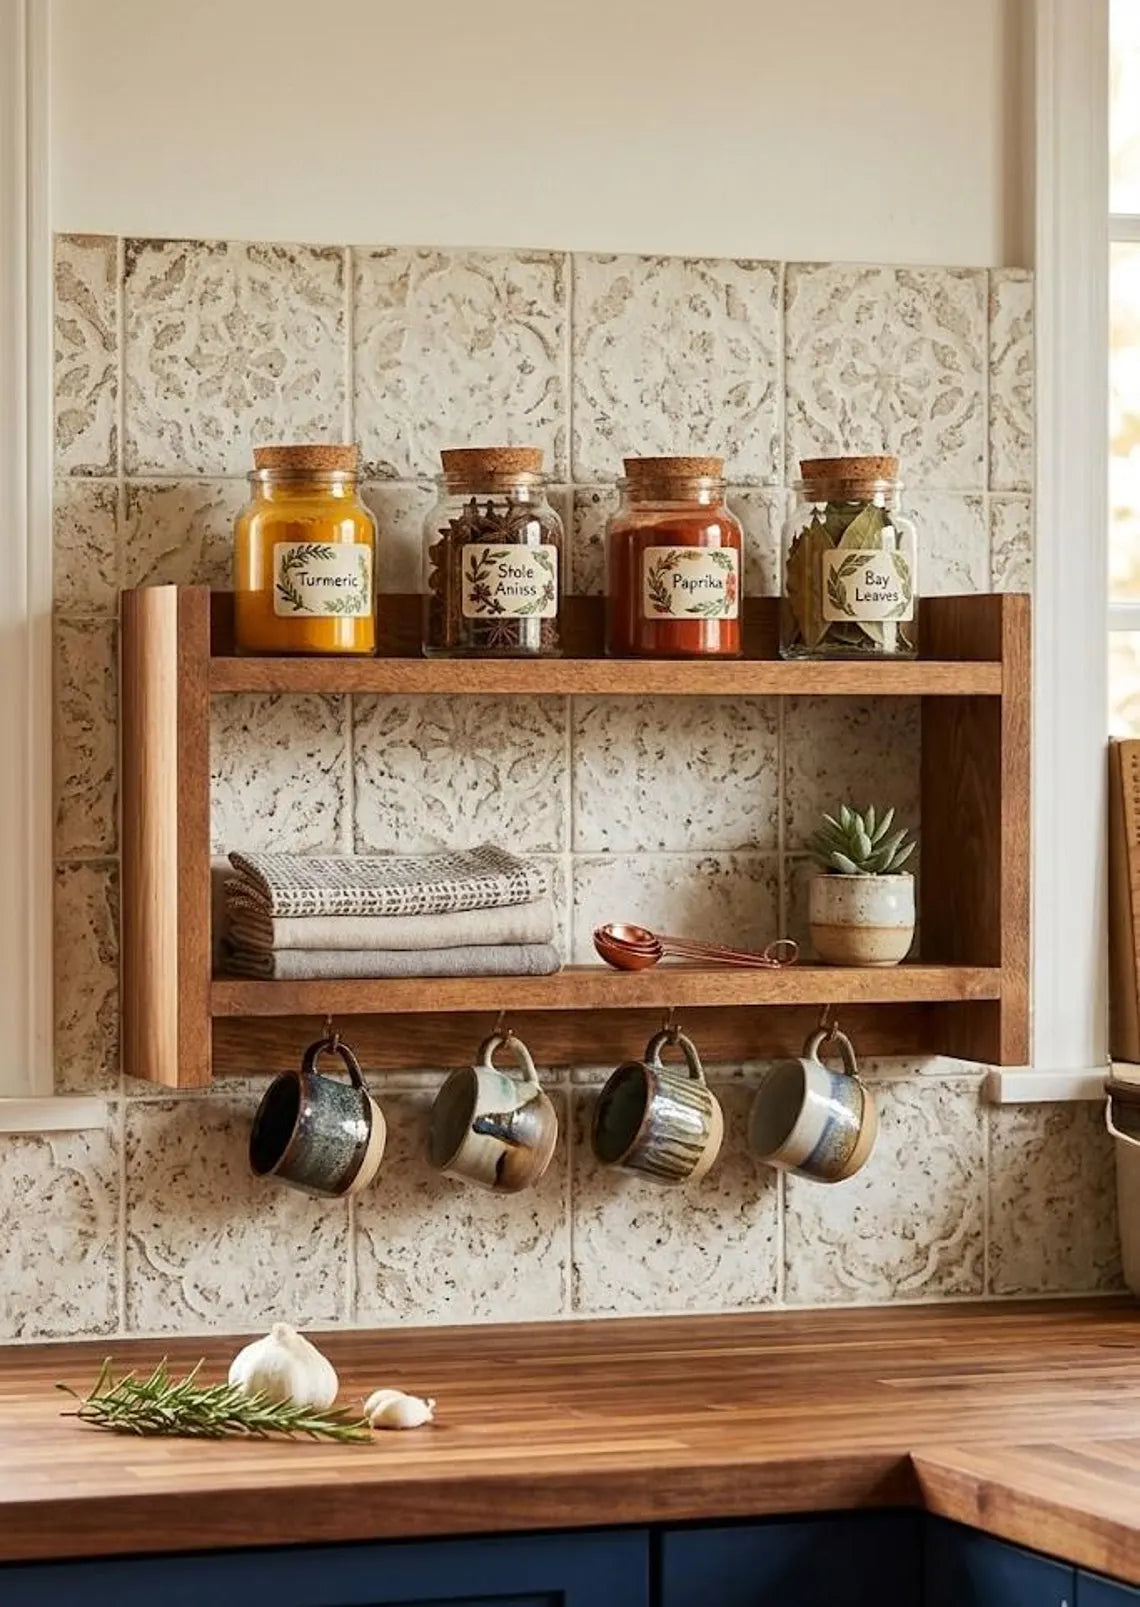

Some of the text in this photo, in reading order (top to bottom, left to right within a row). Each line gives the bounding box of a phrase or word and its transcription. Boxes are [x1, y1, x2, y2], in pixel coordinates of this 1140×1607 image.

[295, 571, 358, 587] Turmeric
[672, 573, 723, 594] Paprika
[865, 570, 890, 589] Bay
[855, 587, 899, 602] Leaves
